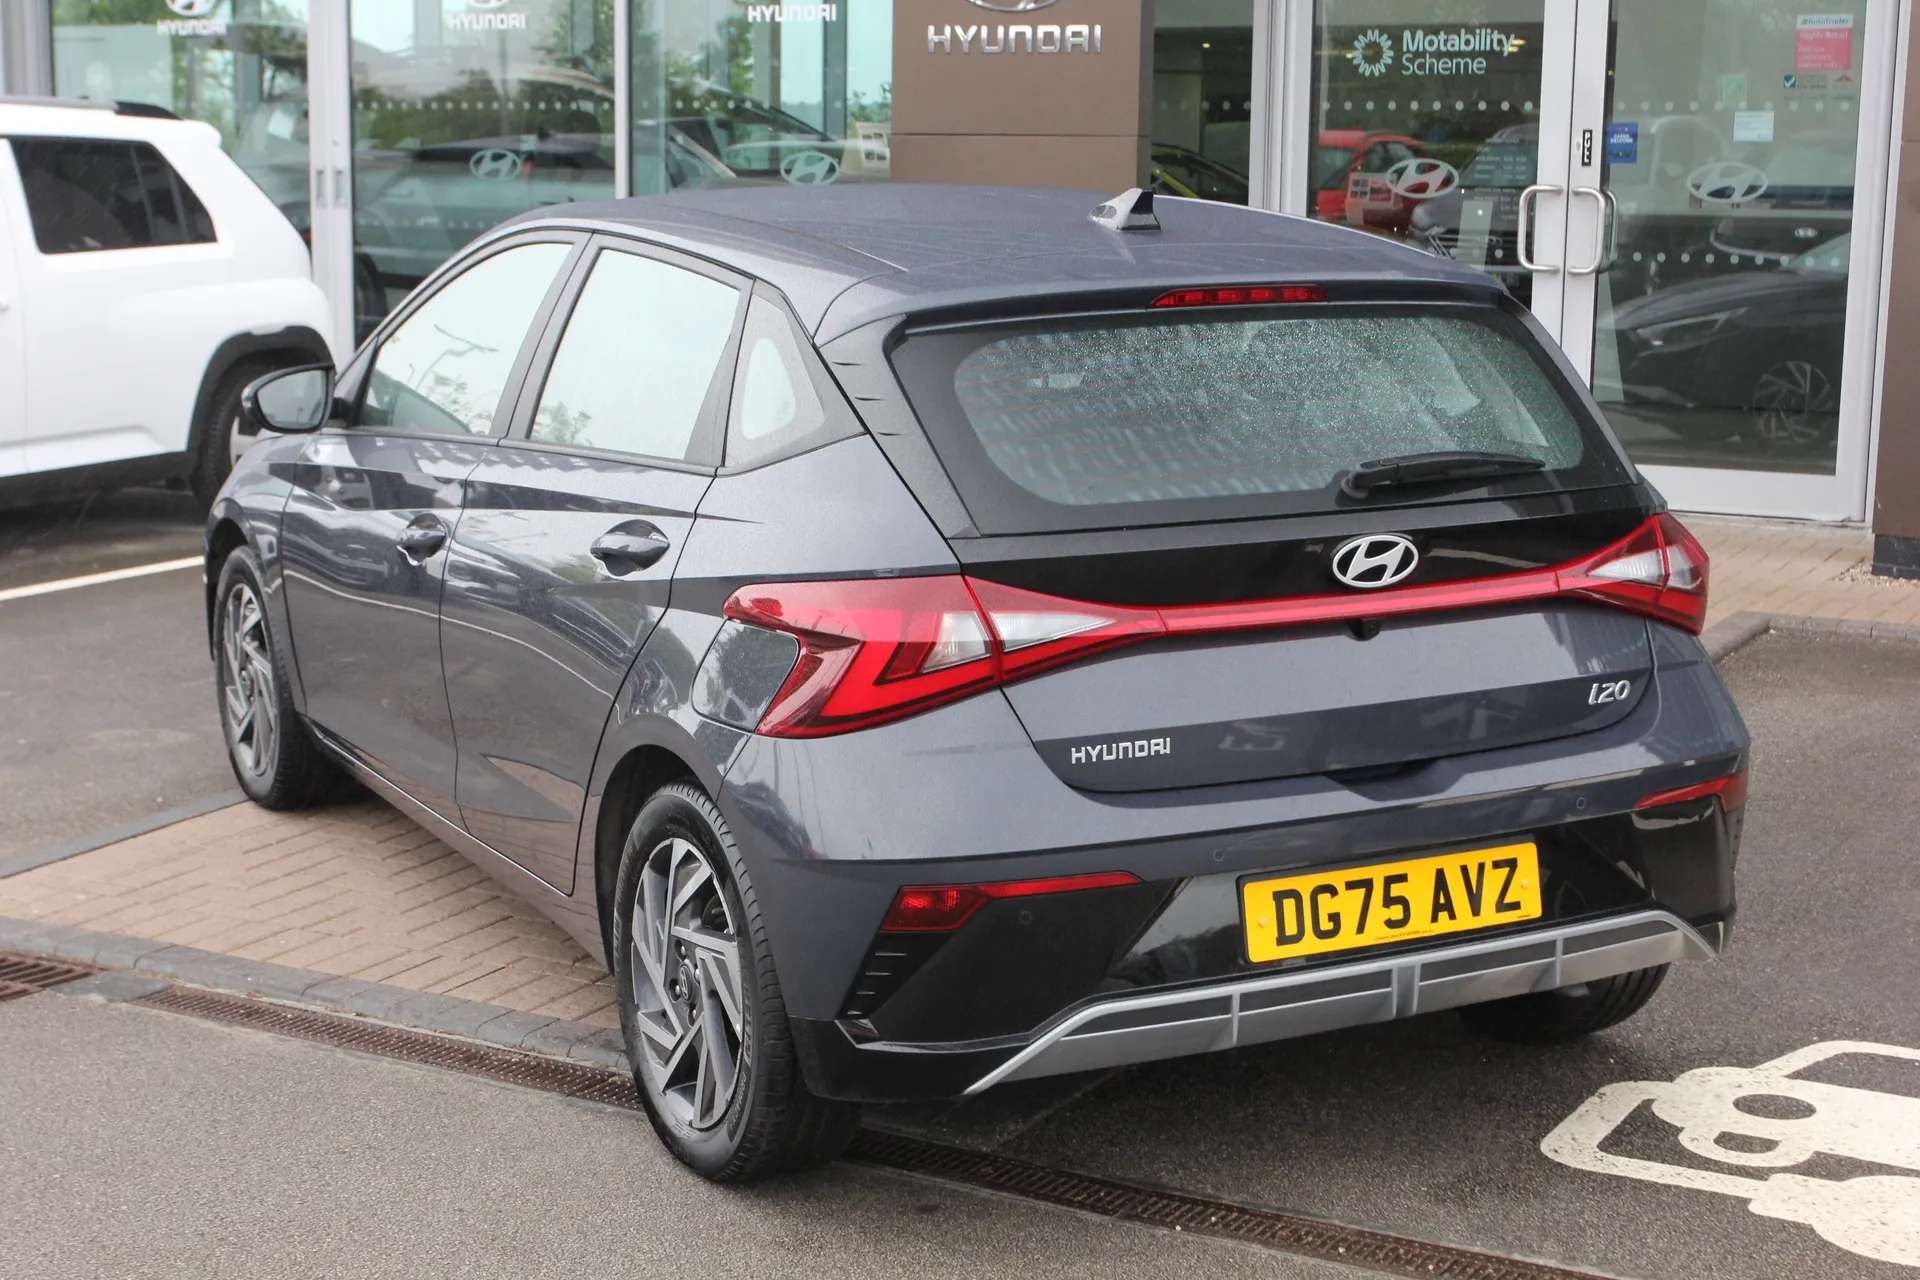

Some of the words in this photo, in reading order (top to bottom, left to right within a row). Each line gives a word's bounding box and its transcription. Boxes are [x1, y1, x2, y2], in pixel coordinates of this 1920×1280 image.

[447, 12, 526, 31] HYUNDAI
[747, 3, 837, 23] HYUNDAI
[156, 18, 227, 36] HYUNDAI
[927, 24, 1102, 54] HYUNDAI
[1402, 28, 1515, 57] Motability
[1401, 53, 1487, 75] Scheme
[1071, 737, 1171, 764] HYUNDAI
[1272, 873, 1411, 947] DG75
[1430, 857, 1522, 924] AVZ
